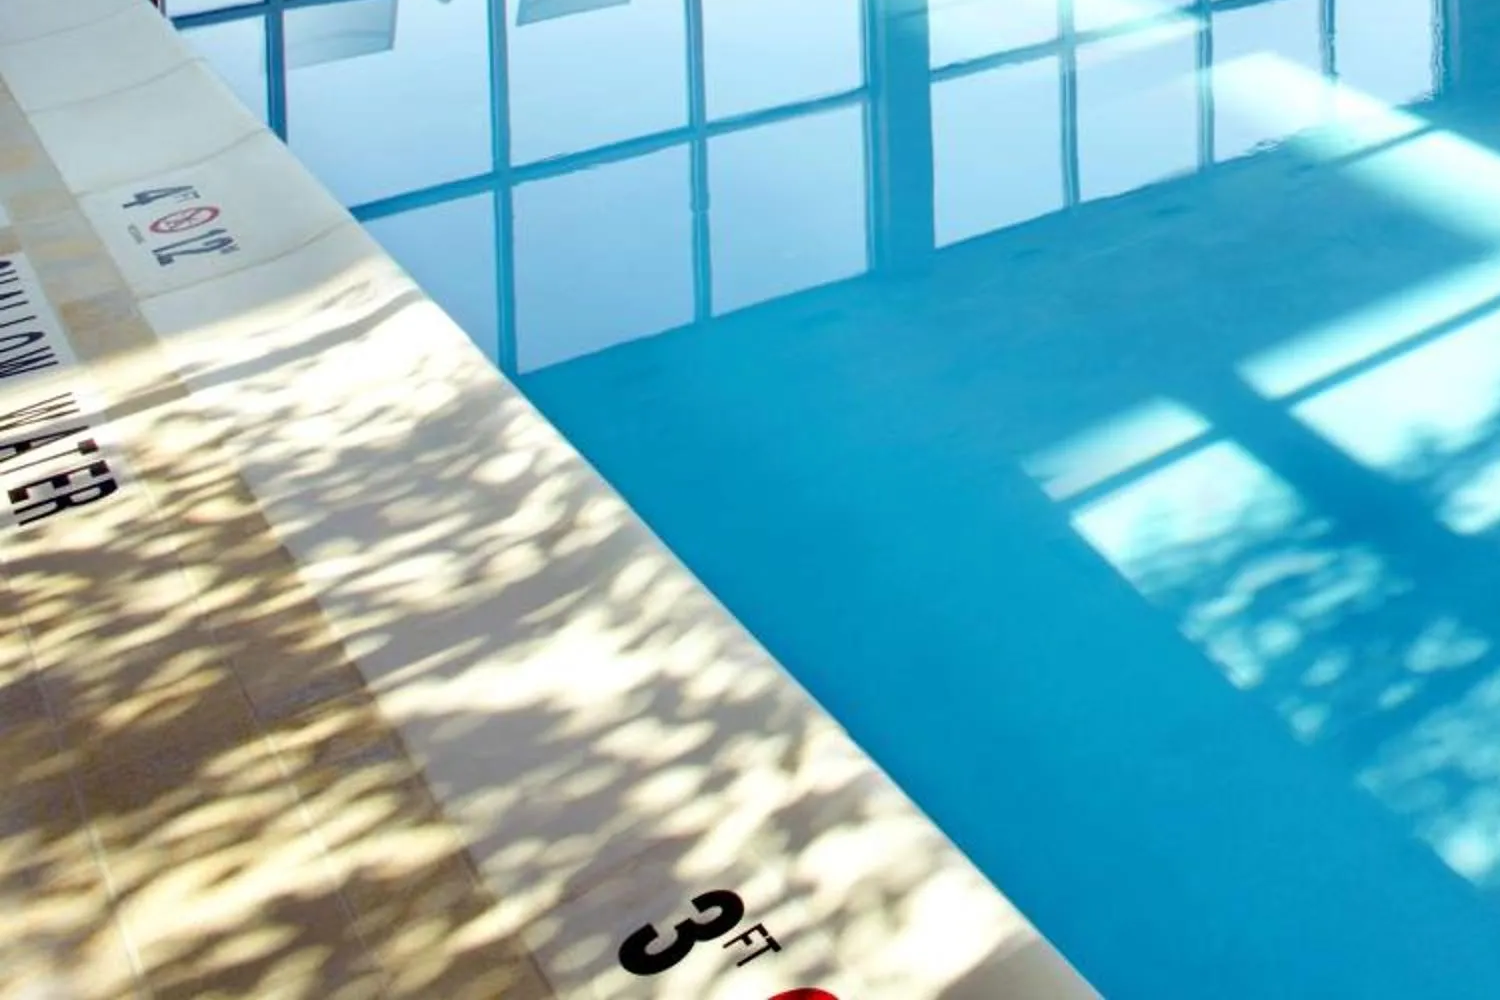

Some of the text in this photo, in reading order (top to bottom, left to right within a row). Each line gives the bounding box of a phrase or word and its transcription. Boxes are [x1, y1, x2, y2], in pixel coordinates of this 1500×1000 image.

[122, 185, 194, 209] 4
[618, 889, 782, 976] 3 FT
